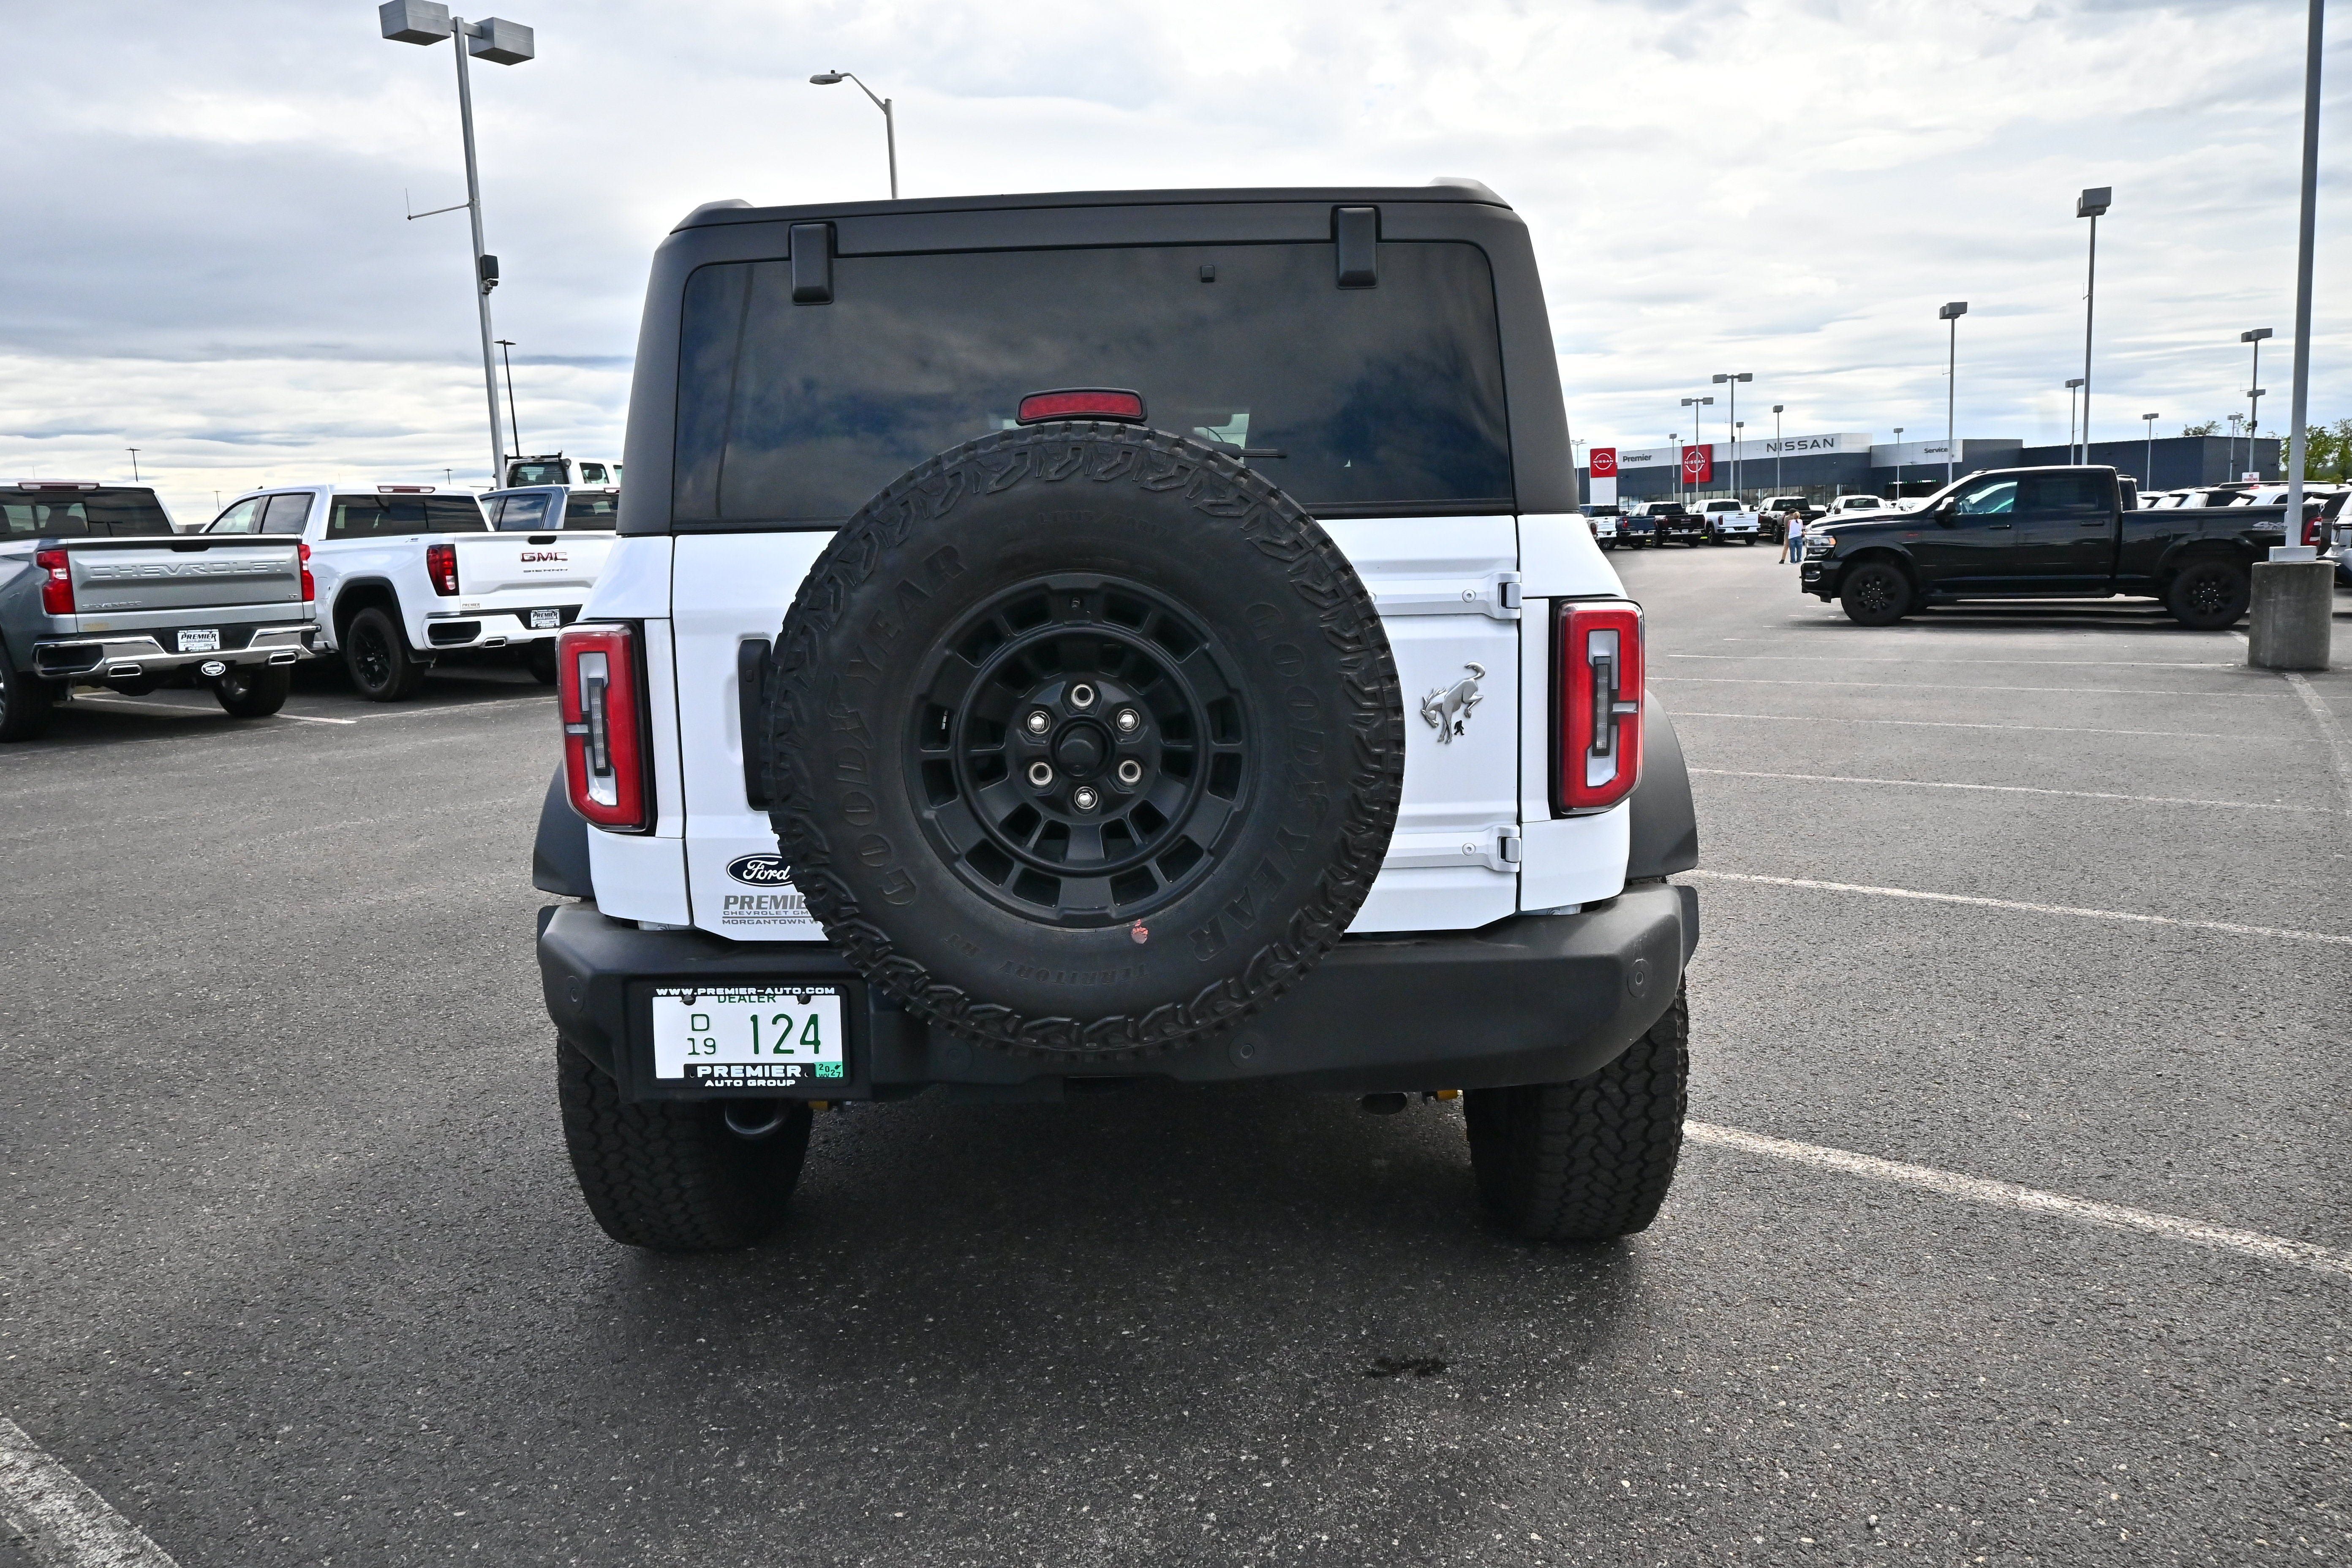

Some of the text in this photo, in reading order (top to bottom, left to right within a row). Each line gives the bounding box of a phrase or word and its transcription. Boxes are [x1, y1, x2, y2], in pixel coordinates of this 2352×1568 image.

[1767, 438, 1834, 452] NISSAN
[1623, 454, 1652, 462] Premier
[521, 552, 568, 562] GMC
[89, 561, 287, 578] CHEVROLET
[181, 634, 216, 642] PREMIER
[743, 860, 791, 880] Ford
[724, 895, 806, 909] PREMIE
[656, 987, 835, 996] WWW.PREMIER-AUTO.COM
[718, 995, 776, 1003] DEALER
[691, 1014, 710, 1031] D
[750, 1013, 821, 1055] 124
[687, 1037, 716, 1055] 19
[697, 1065, 802, 1078] PREMIER
